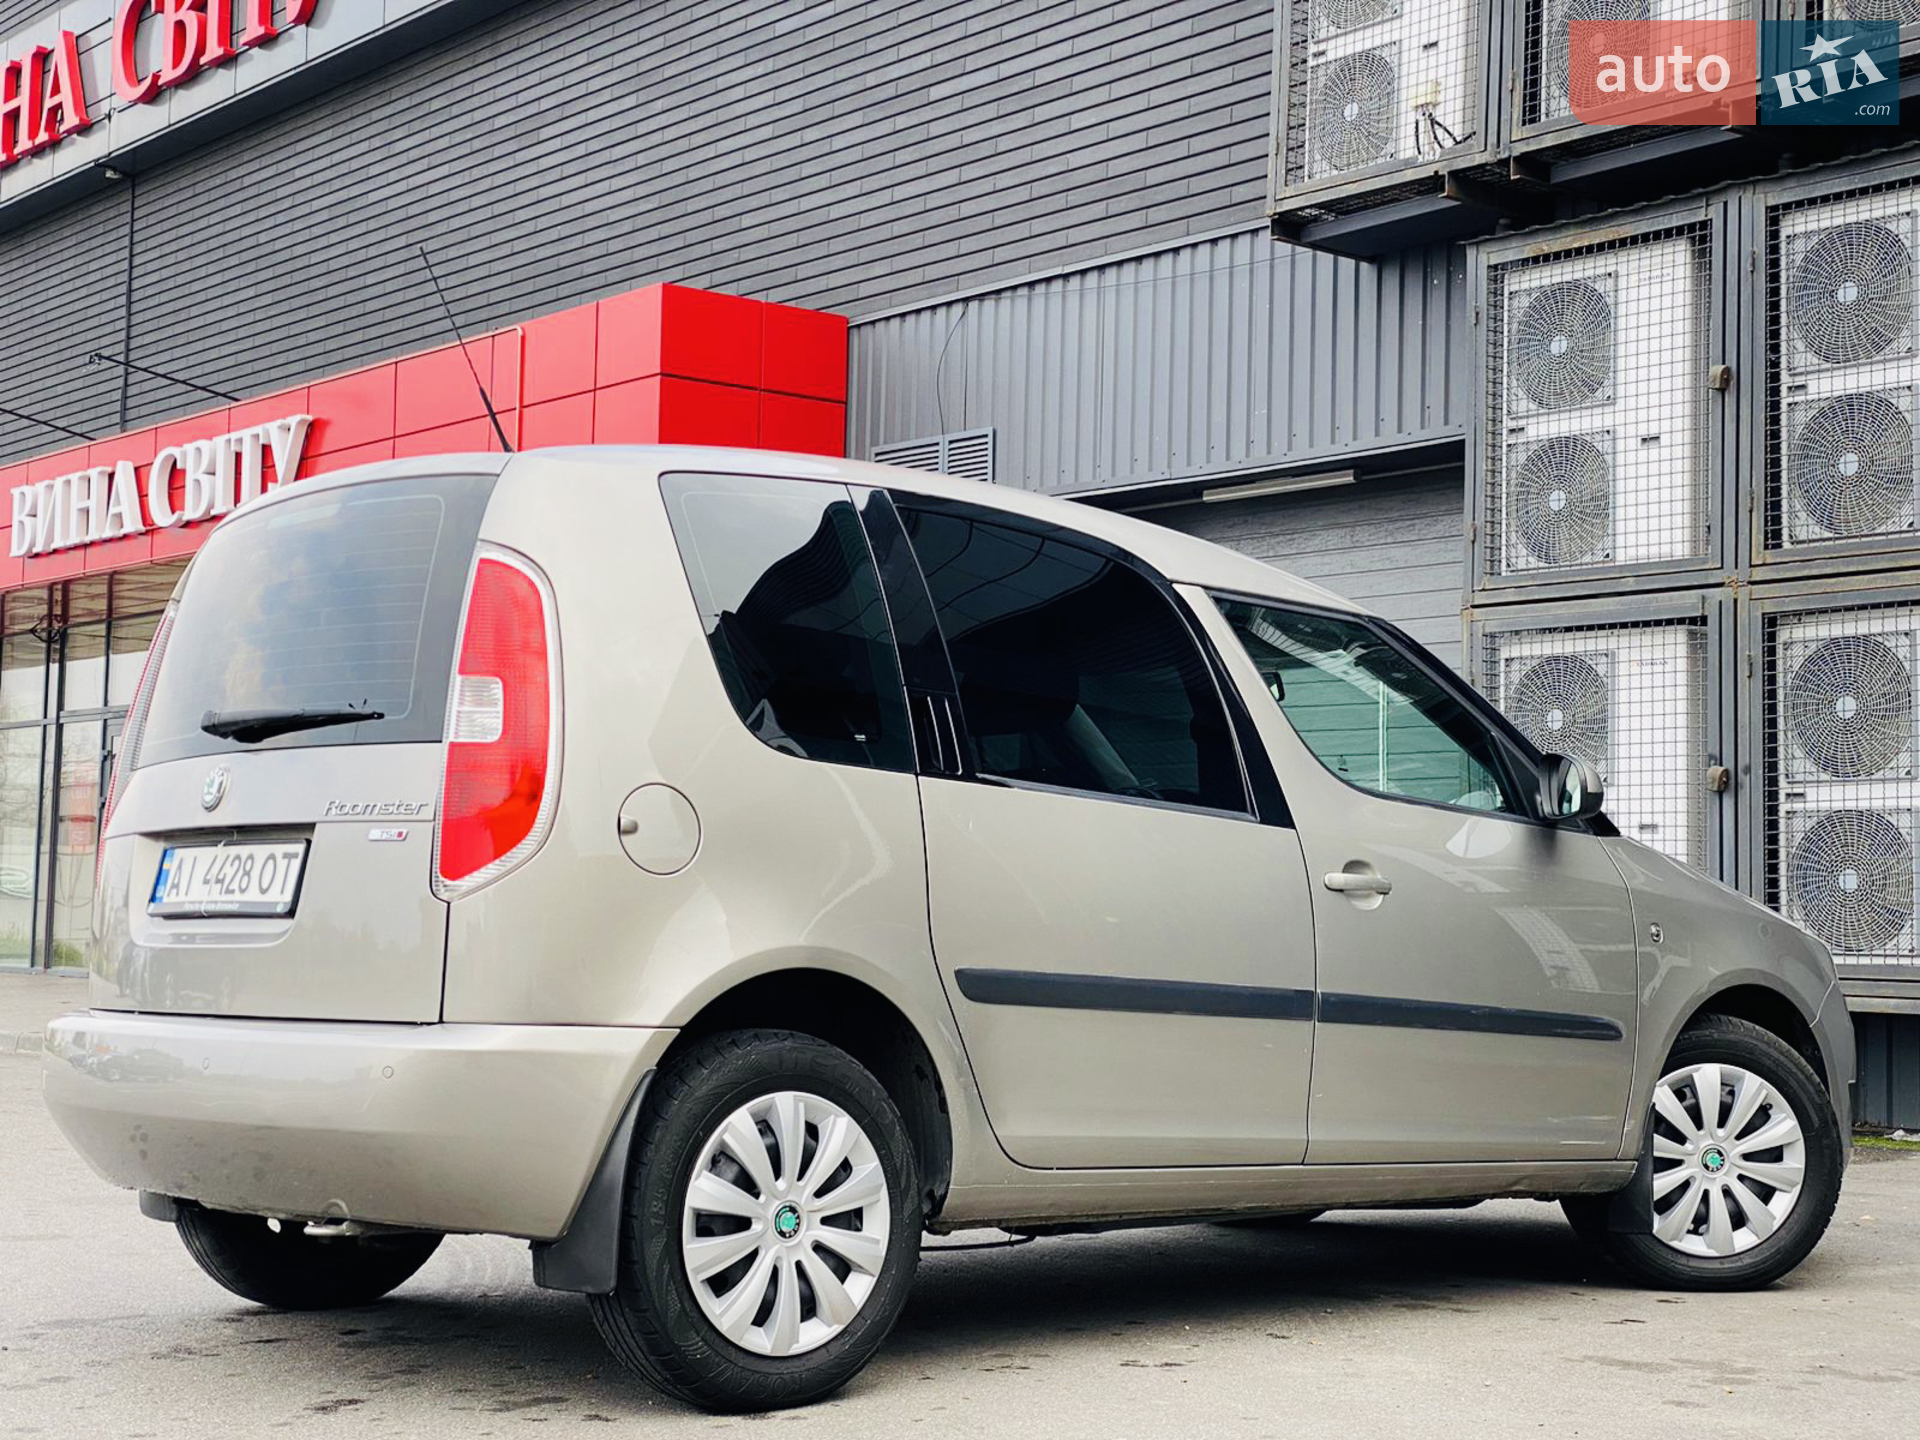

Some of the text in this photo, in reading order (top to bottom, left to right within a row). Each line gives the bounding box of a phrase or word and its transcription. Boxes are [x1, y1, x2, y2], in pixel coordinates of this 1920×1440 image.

[111, 0, 320, 104] СВІ
[9, 413, 313, 558] ВИНА СВІТУ
[323, 800, 429, 817] Roomster
[166, 851, 300, 898] AI 4428 OT
